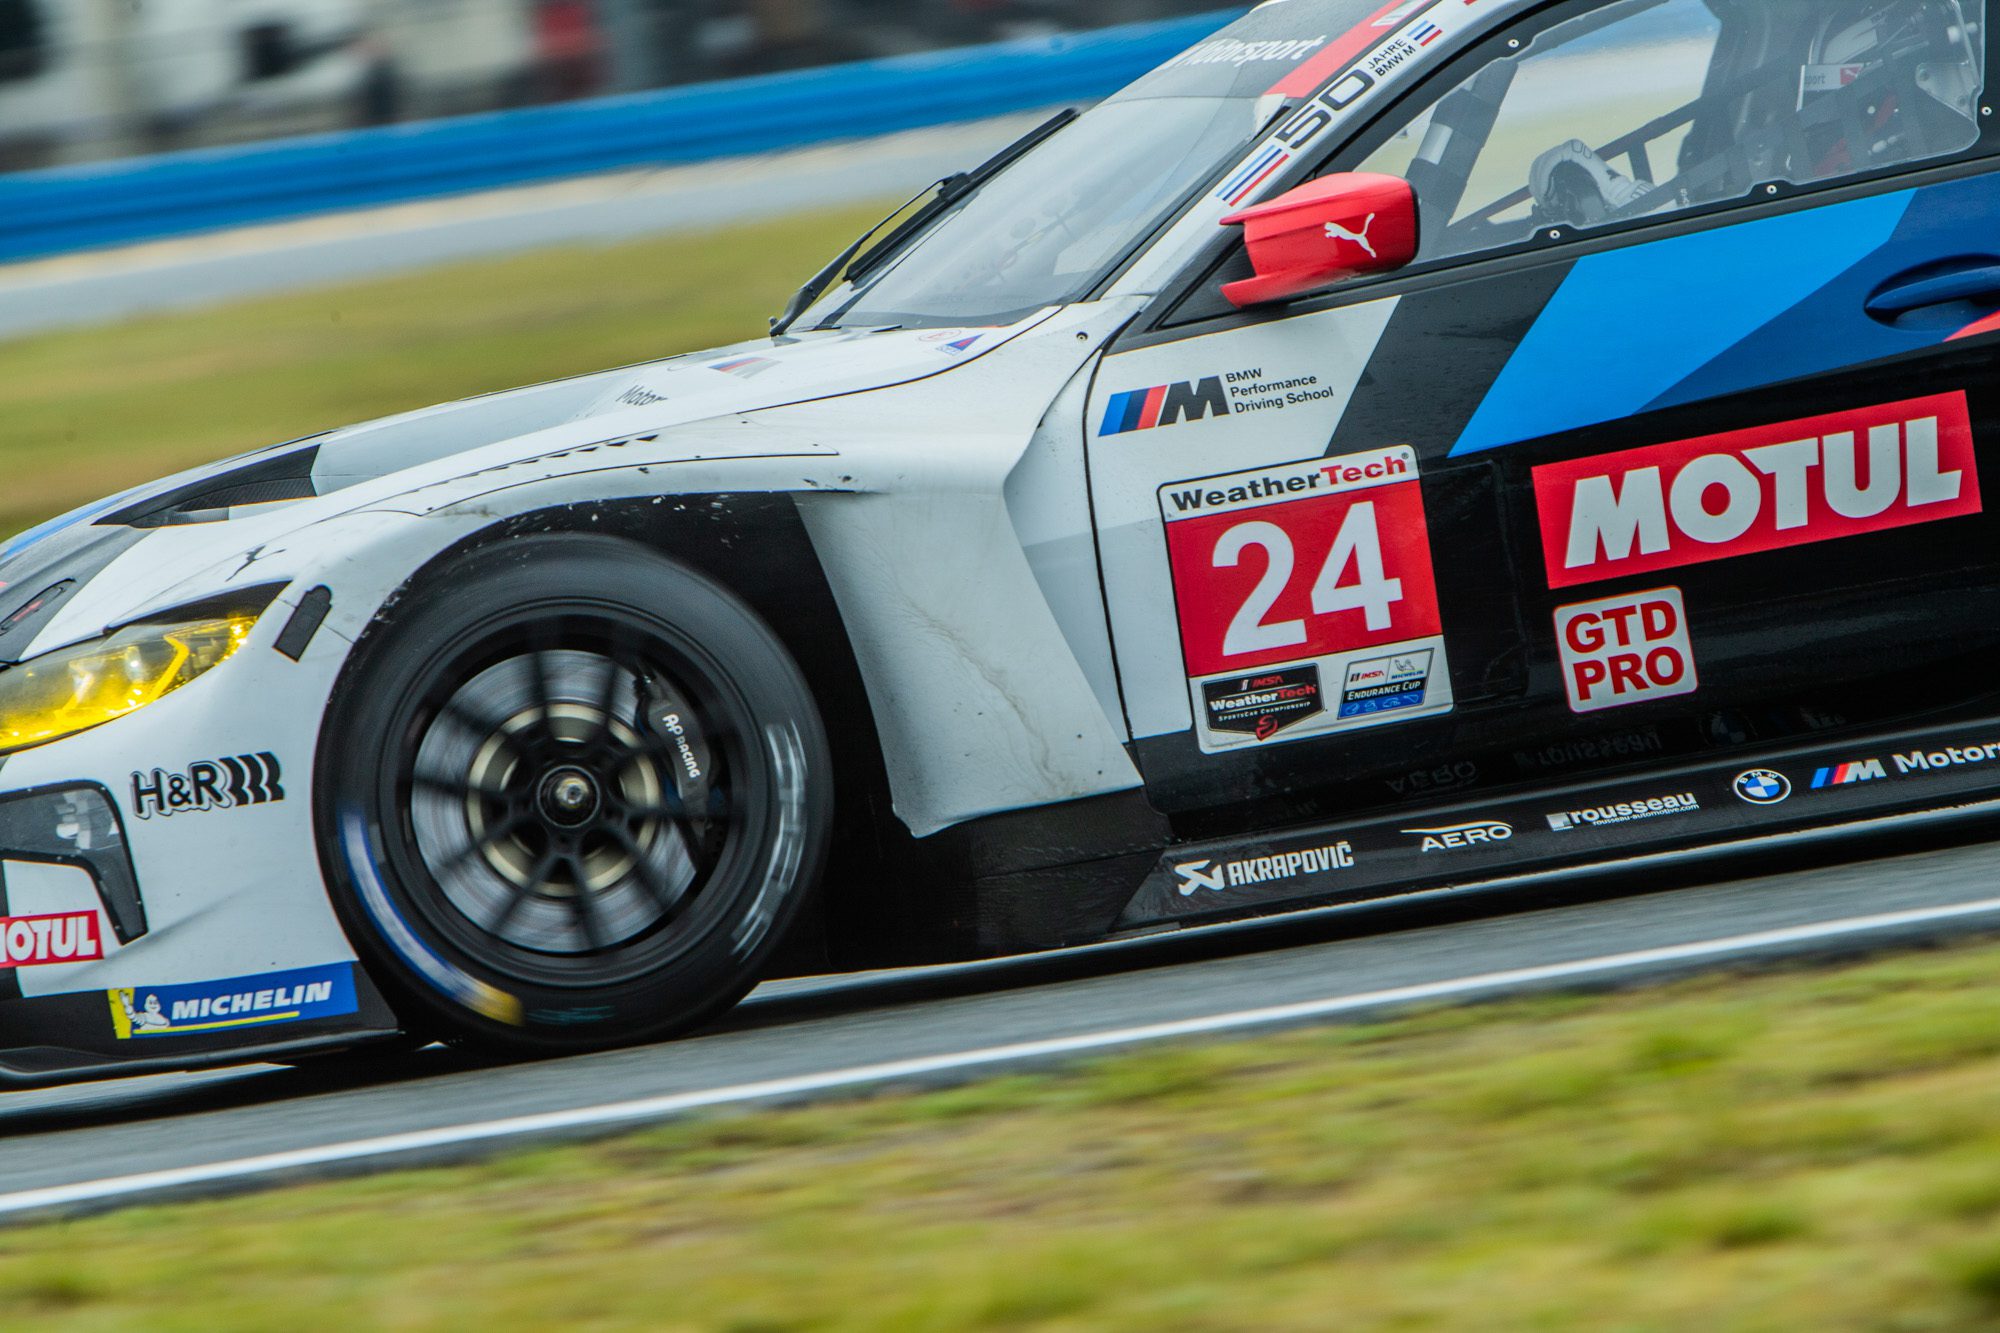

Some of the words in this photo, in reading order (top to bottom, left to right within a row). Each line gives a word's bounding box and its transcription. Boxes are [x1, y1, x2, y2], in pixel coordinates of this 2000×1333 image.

[1368, 39, 1407, 69] JAHRE
[1374, 53, 1404, 77] BMW
[1402, 44, 1416, 56] M
[1275, 69, 1375, 150] 50
[1225, 368, 1262, 383] BMW
[1230, 374, 1317, 398] Performance
[1234, 397, 1284, 414] Driving
[1286, 386, 1334, 405] School
[1565, 416, 1962, 569] MOTUL
[1212, 500, 1403, 657] 24
[1565, 599, 1678, 654] GTD
[1573, 646, 1685, 701] PRO
[1347, 684, 1400, 701] ENDURANCE
[1402, 681, 1421, 691] CUP
[675, 735, 701, 778] RACING
[1891, 742, 2000, 774] Motor
[131, 760, 232, 820] H&R
[1568, 792, 1698, 825] rousseau
[1592, 804, 1700, 826] rousseau-automotive.com
[1421, 825, 1514, 852] AERO
[0, 916, 97, 962] OTUL
[172, 981, 332, 1020] MICHELIN
